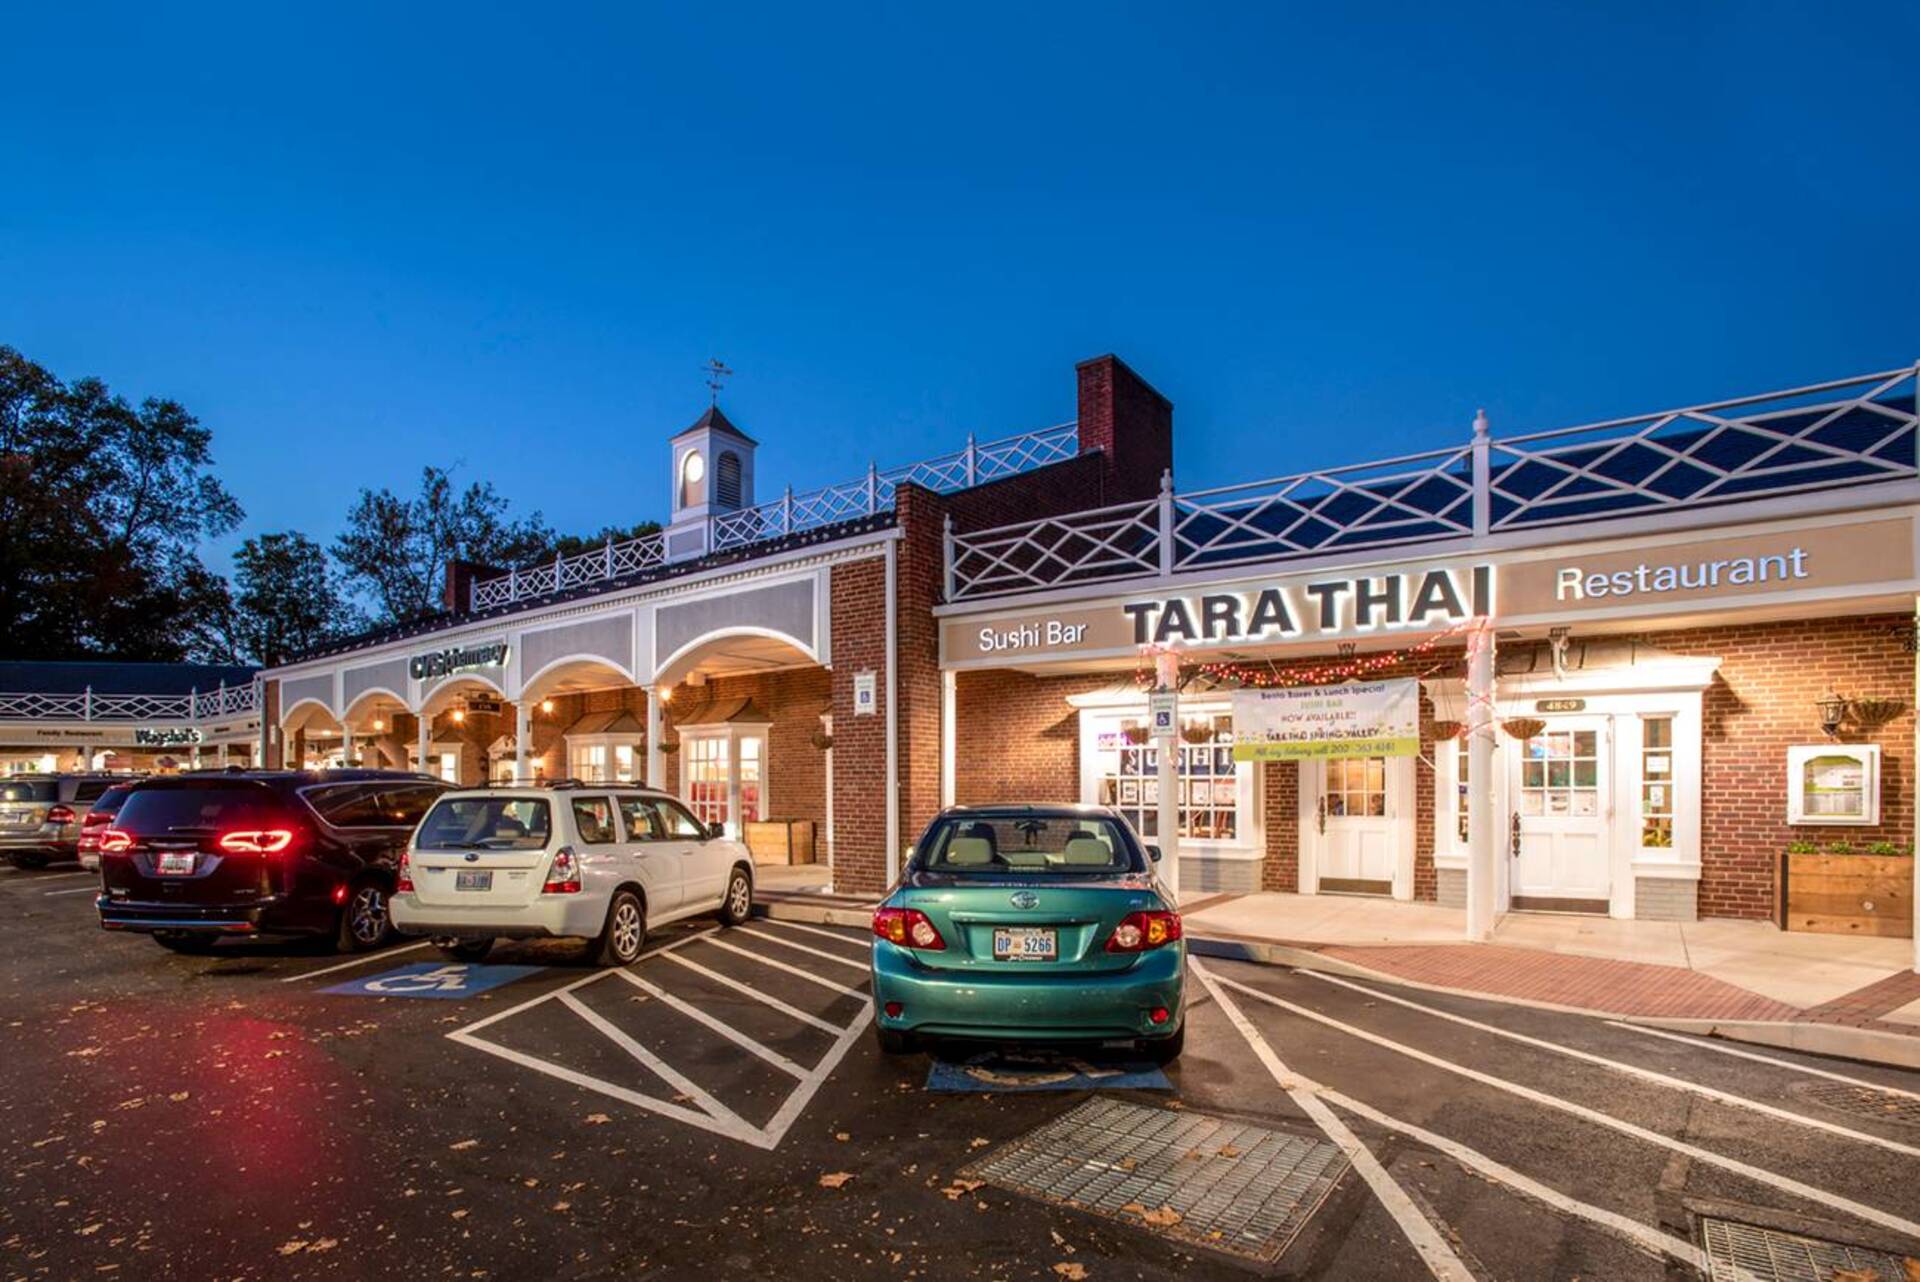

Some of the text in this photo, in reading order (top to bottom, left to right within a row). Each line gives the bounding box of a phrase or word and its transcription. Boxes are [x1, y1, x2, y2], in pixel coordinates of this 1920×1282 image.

[1556, 547, 1809, 601] Restaurant
[1123, 565, 1492, 645] TARA THAI
[979, 621, 1087, 651] Sushi Bar
[1323, 687, 1349, 696] Lunch
[1352, 684, 1385, 695] Special
[997, 937, 1052, 952] DP 5266
